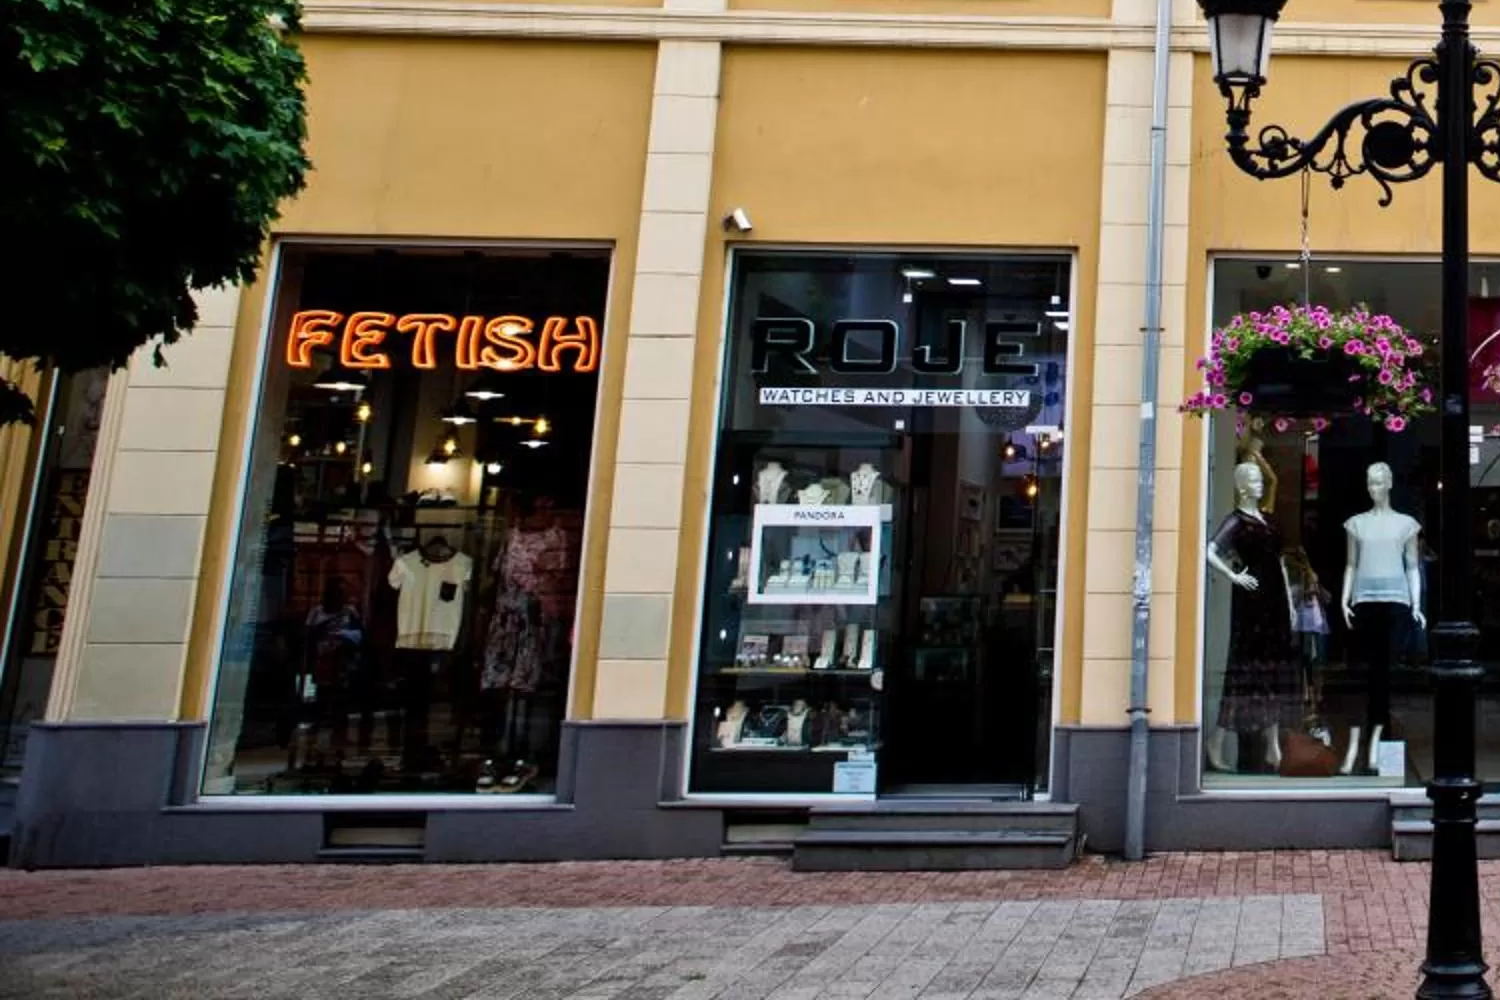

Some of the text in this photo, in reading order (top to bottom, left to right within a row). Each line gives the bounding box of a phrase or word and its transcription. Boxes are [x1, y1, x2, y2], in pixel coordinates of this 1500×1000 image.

[287, 309, 600, 373] FETISH
[751, 317, 1041, 376] ROJE
[763, 389, 1027, 405] WATCHES AND JEWELLERY
[793, 511, 845, 520] PANDORA
